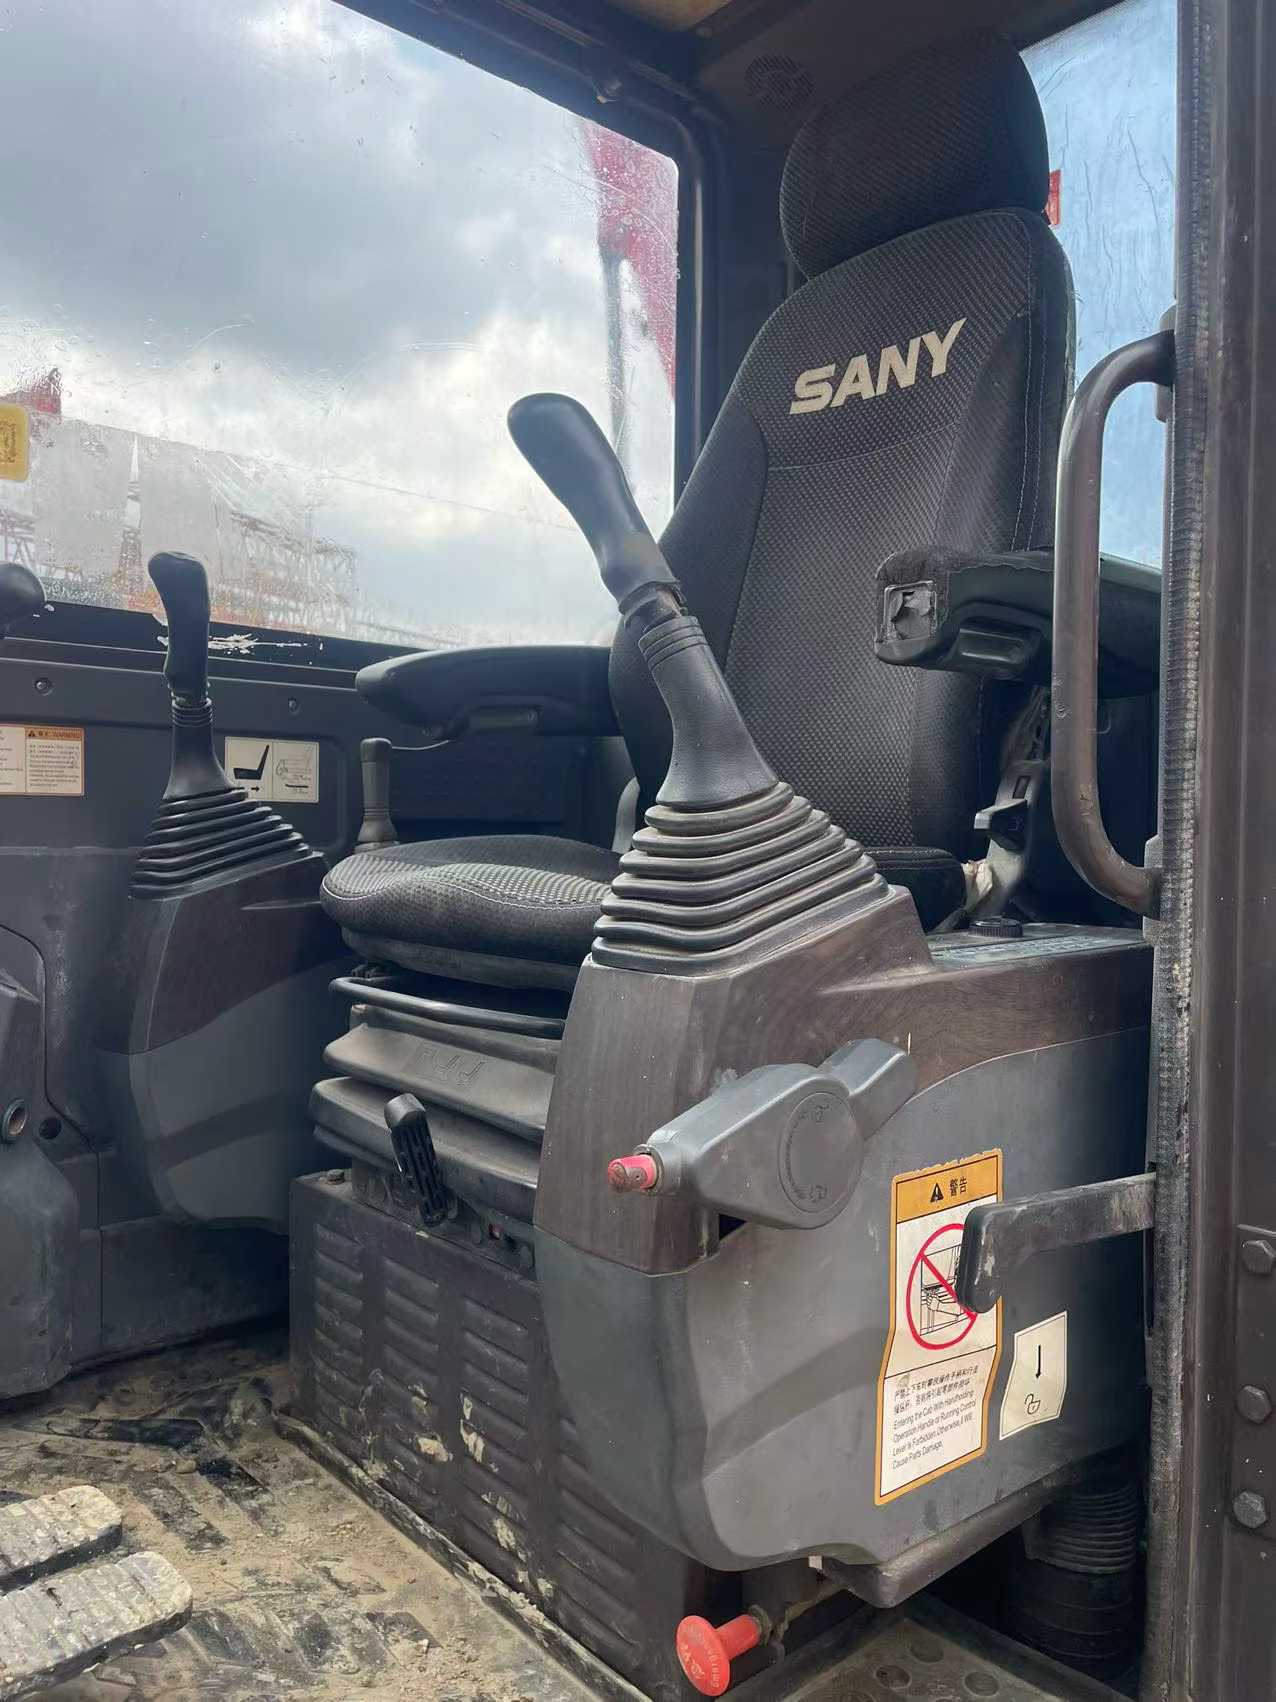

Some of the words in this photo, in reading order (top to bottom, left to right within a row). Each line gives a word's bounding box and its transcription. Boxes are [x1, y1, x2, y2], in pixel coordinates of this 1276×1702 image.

[790, 317, 967, 414] SANY
[949, 1176, 967, 1197] 警告
[940, 1407, 960, 1420] Running
[960, 1399, 976, 1412] Control
